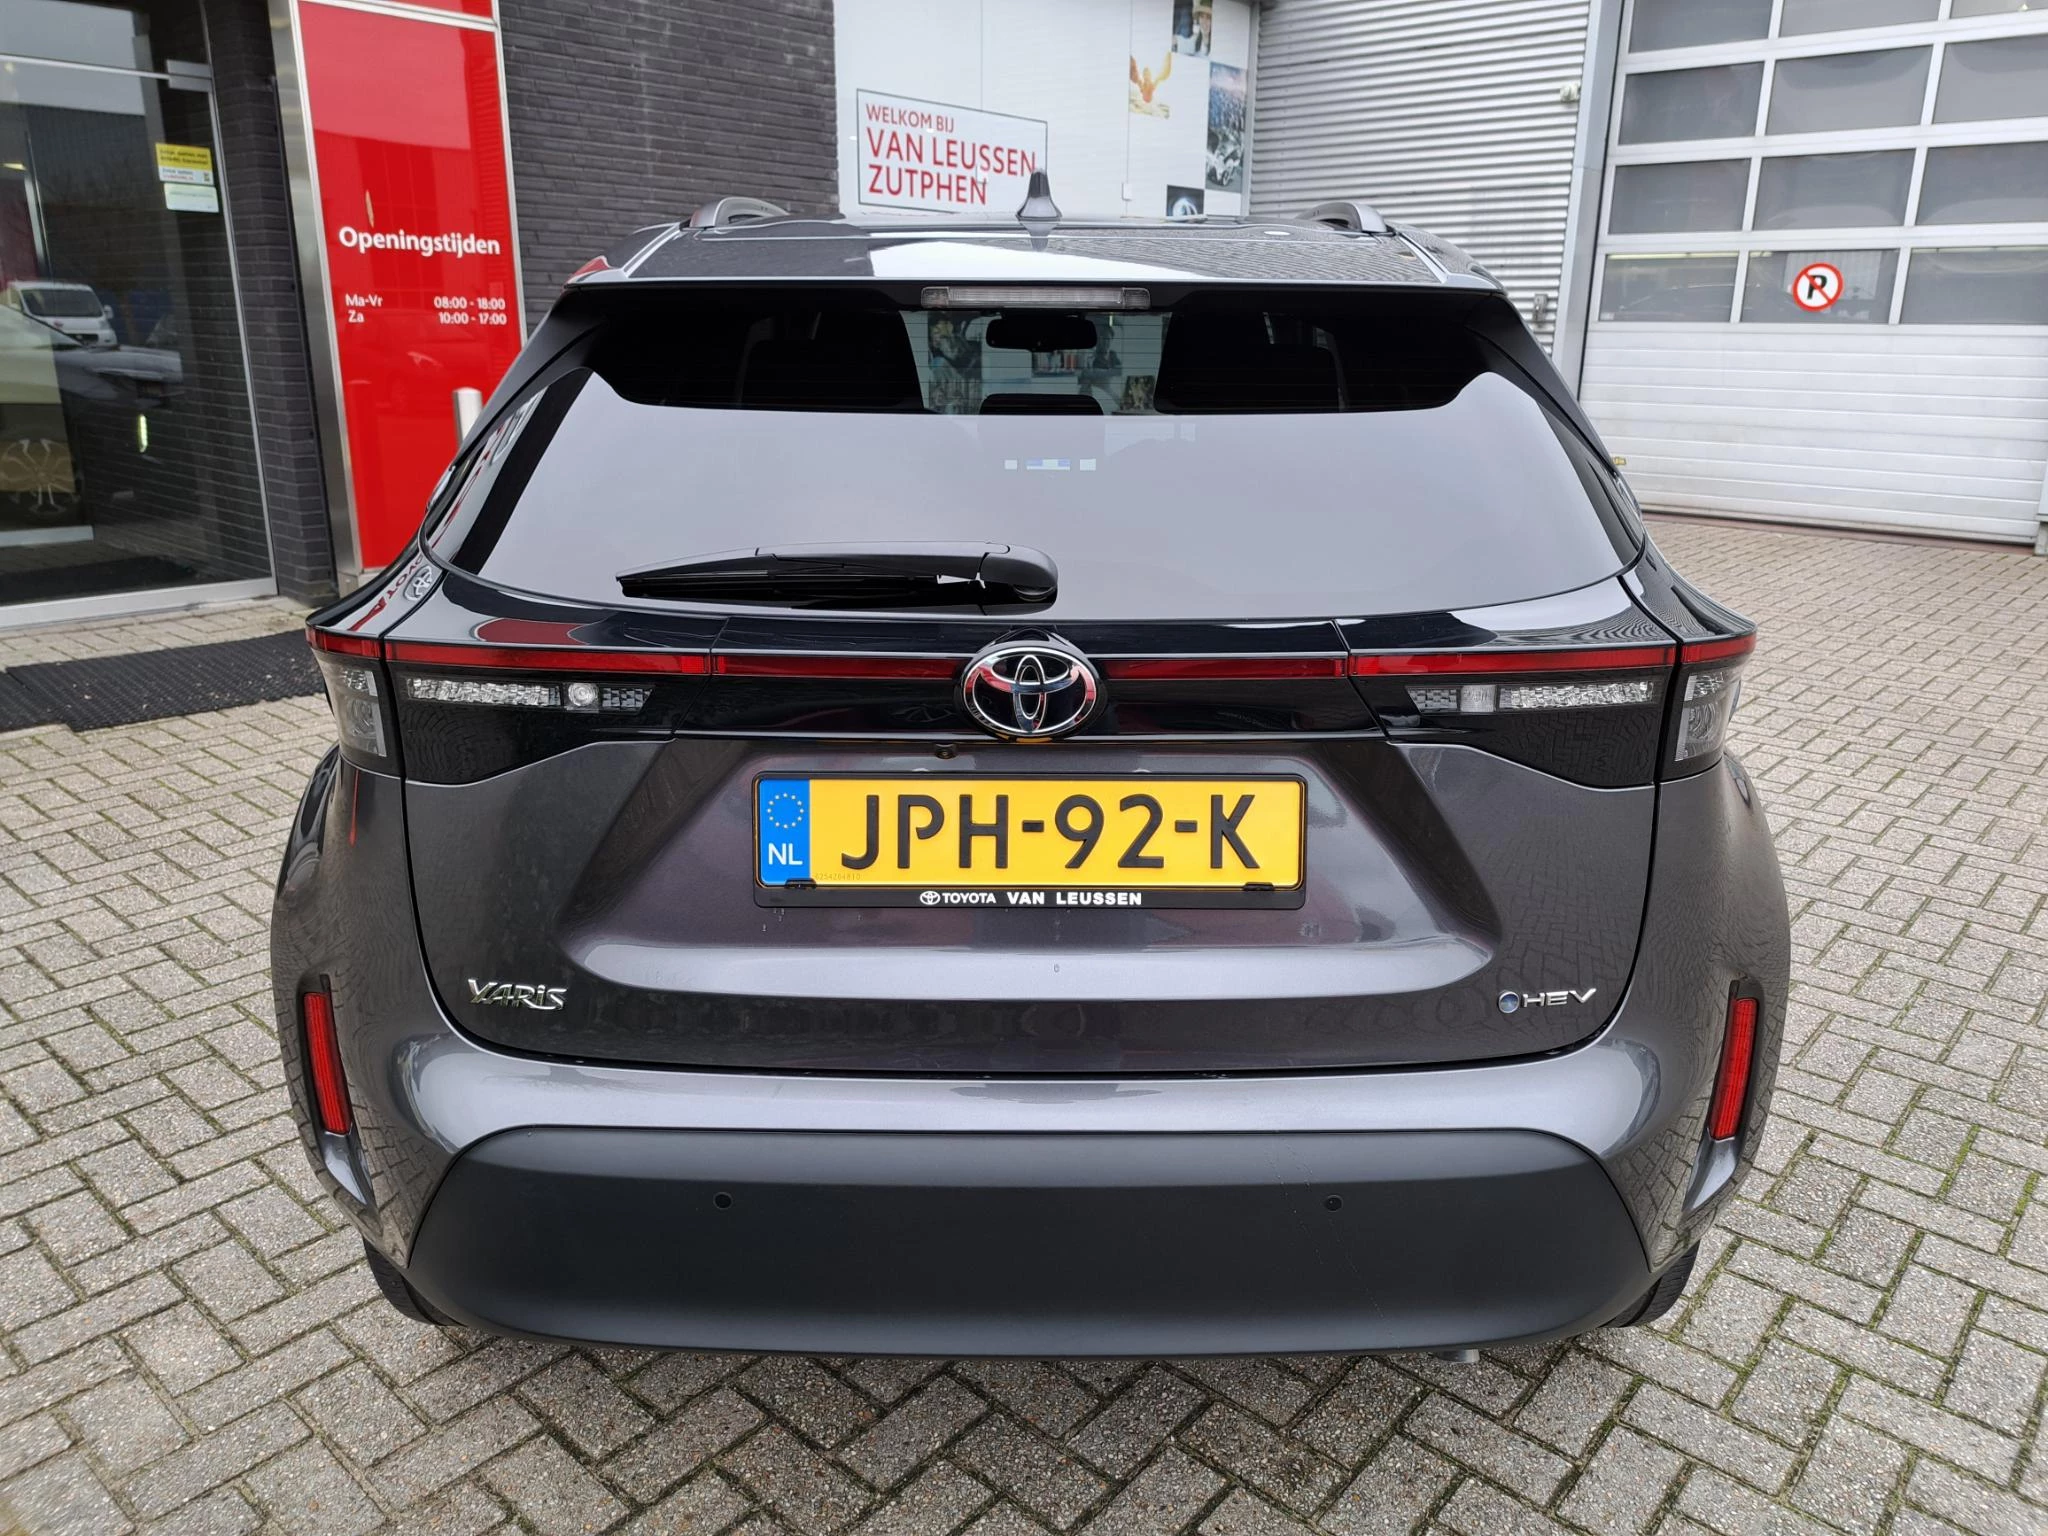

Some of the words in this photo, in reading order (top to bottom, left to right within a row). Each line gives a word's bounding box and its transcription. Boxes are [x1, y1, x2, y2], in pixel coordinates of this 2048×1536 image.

[866, 103, 932, 129] WELKOM
[936, 115, 955, 133] BIJ
[867, 127, 923, 163] VAN
[932, 136, 1036, 177] LEUSSEN
[868, 163, 987, 205] ZUTPHEN
[338, 226, 501, 259] Openingstijden
[345, 293, 383, 307] Ma-Vr
[433, 296, 467, 309] 08:00
[477, 297, 506, 310] 18:00
[348, 310, 365, 323] Za
[438, 311, 469, 325] 10:00
[479, 312, 507, 325] 17:00
[841, 794, 1260, 870] JPH-92-K
[768, 842, 803, 865] NL
[941, 892, 997, 904] TOYOTA
[1006, 891, 1045, 905] VAN
[1056, 891, 1142, 905] LEUSSEN
[1522, 987, 1597, 1008] HEV
